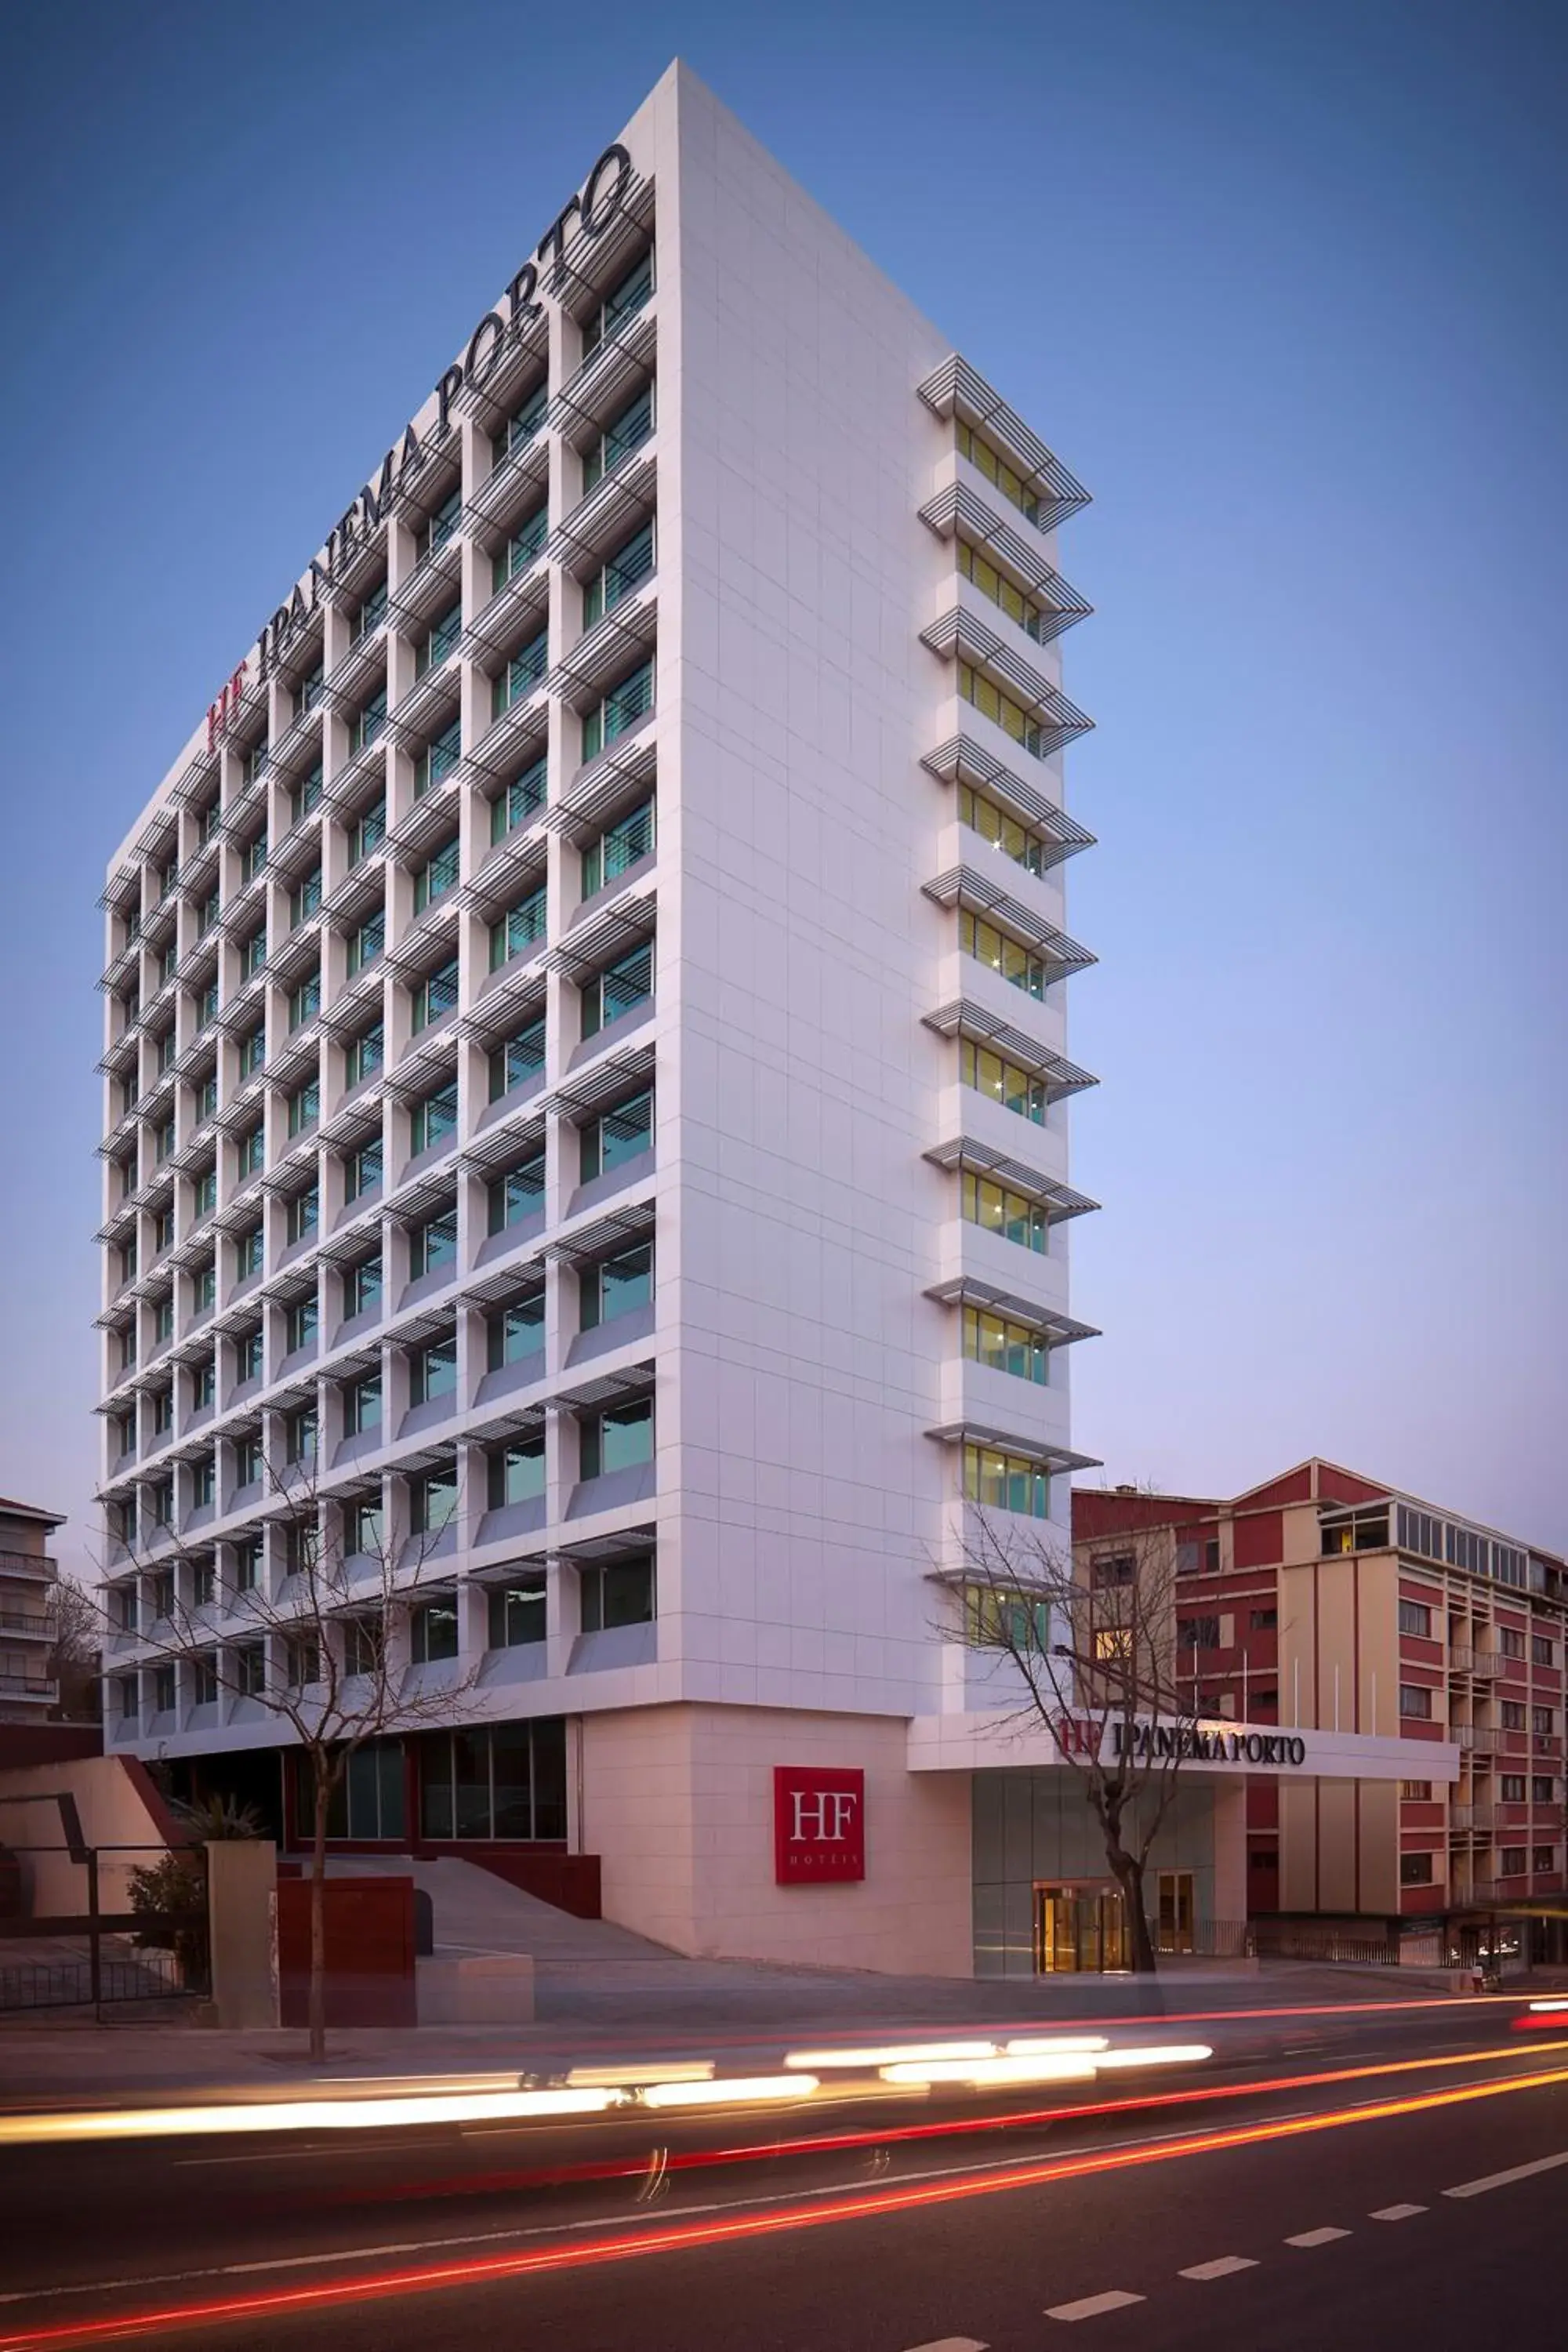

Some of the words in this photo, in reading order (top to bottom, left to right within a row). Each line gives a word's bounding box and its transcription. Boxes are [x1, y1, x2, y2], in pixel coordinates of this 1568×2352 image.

[257, 422, 427, 686] IPANEMA
[434, 143, 631, 445] PORTO
[1112, 1723, 1229, 1761] IPANEMA
[1232, 1733, 1305, 1766] PORTO
[789, 1791, 857, 1840] HF
